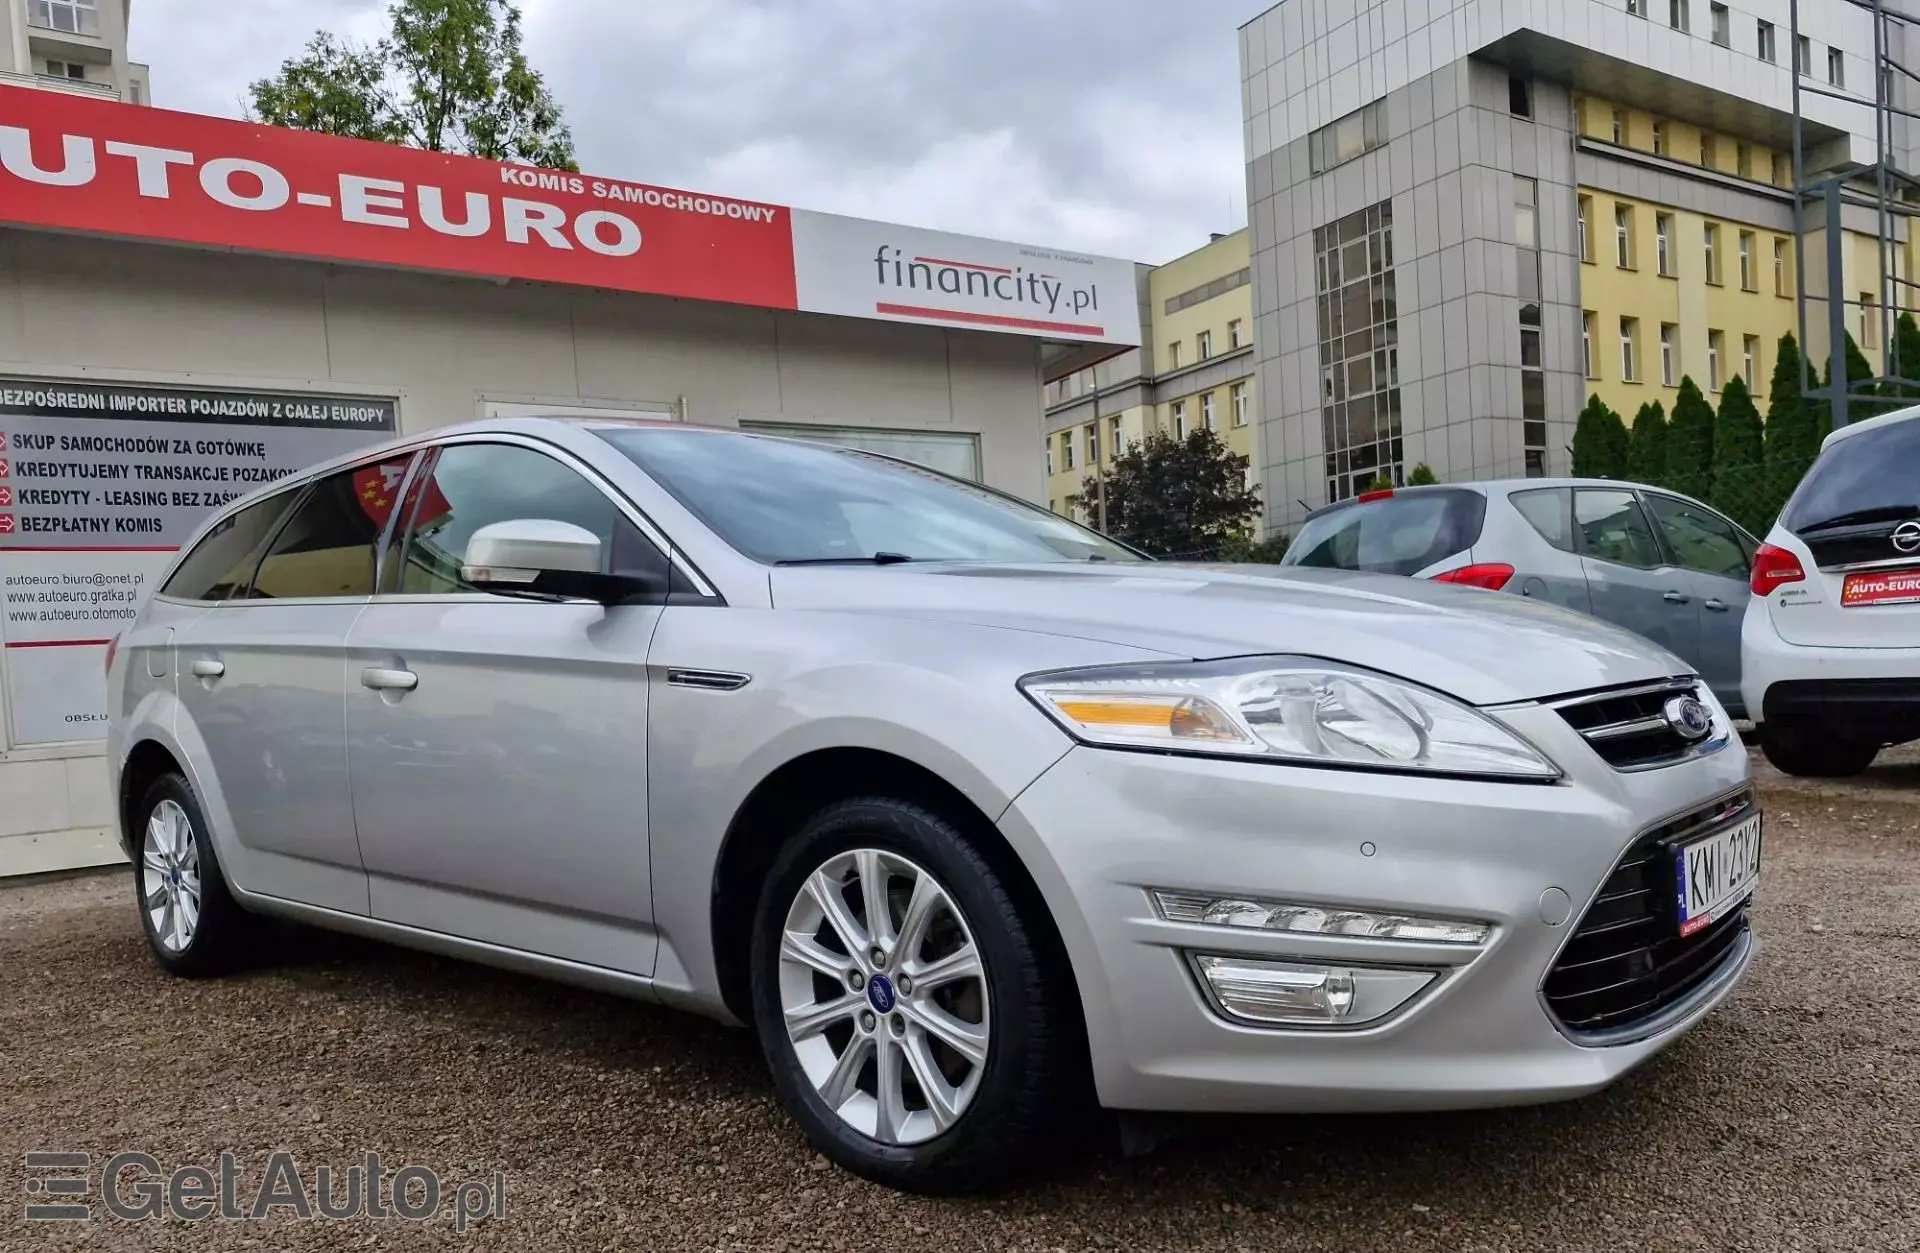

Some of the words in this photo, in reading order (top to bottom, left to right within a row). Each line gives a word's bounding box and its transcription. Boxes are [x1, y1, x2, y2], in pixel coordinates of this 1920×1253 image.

[500, 167, 585, 194] KOMIS
[592, 181, 776, 224] SAMOCHODOWY
[874, 245, 1098, 315] financity.pl
[110, 395, 187, 413] IMPORTER
[191, 399, 268, 417] POJAZDÓW
[272, 403, 282, 418] Z
[285, 404, 327, 420] CAŁEJ
[331, 406, 384, 423] EUROPY
[13, 434, 55, 450] SKUP
[60, 435, 168, 454] SAMOCHODÓW
[173, 440, 192, 454] ZA
[196, 438, 266, 461] GOTÓWKĘ
[15, 462, 129, 479] KREDYTUJEMY
[134, 465, 228, 481] TRANSAKCJE
[18, 489, 90, 505] KREDYTY
[104, 491, 168, 506] LEASING
[172, 492, 200, 506] BEZ
[21, 517, 109, 533] BEZPŁATNY
[115, 518, 163, 533] KOMIS
[5, 573, 144, 586] autoeuro.biuro@onet.pl
[7, 588, 137, 604] www.autoeuro.gratka.pl
[1690, 840, 1721, 910] KMI
